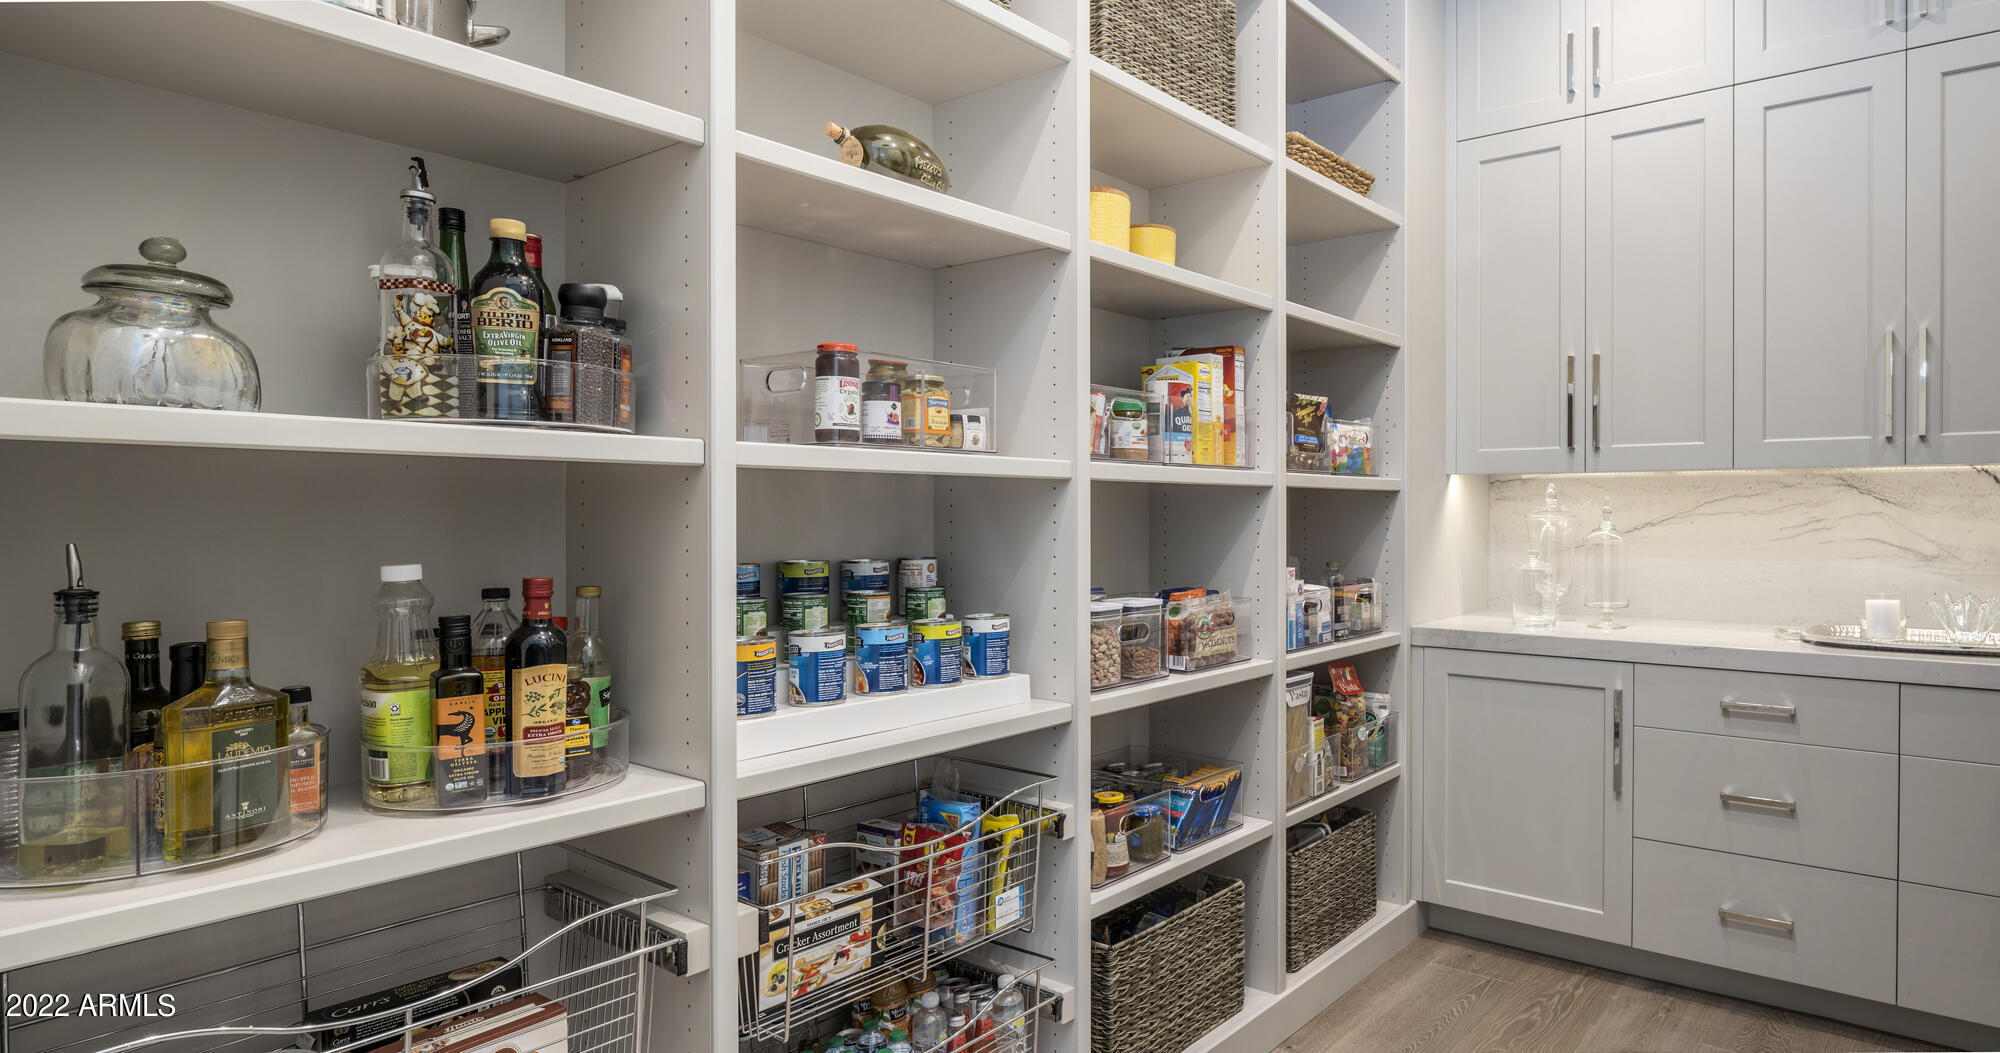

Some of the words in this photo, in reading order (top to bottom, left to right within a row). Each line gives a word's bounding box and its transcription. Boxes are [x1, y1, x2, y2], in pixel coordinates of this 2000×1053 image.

[480, 311, 530, 320] FILIPPO
[476, 317, 533, 329] BERIO
[840, 380, 859, 389] LINDSA
[524, 672, 566, 687] LUCINI
[1339, 682, 1360, 694] Pasta
[1288, 690, 1308, 702] Pasta
[484, 708, 505, 717] APPL
[217, 744, 271, 761] LAUDEMIO
[224, 806, 267, 820] ANTINORI
[811, 917, 859, 942] Assortment
